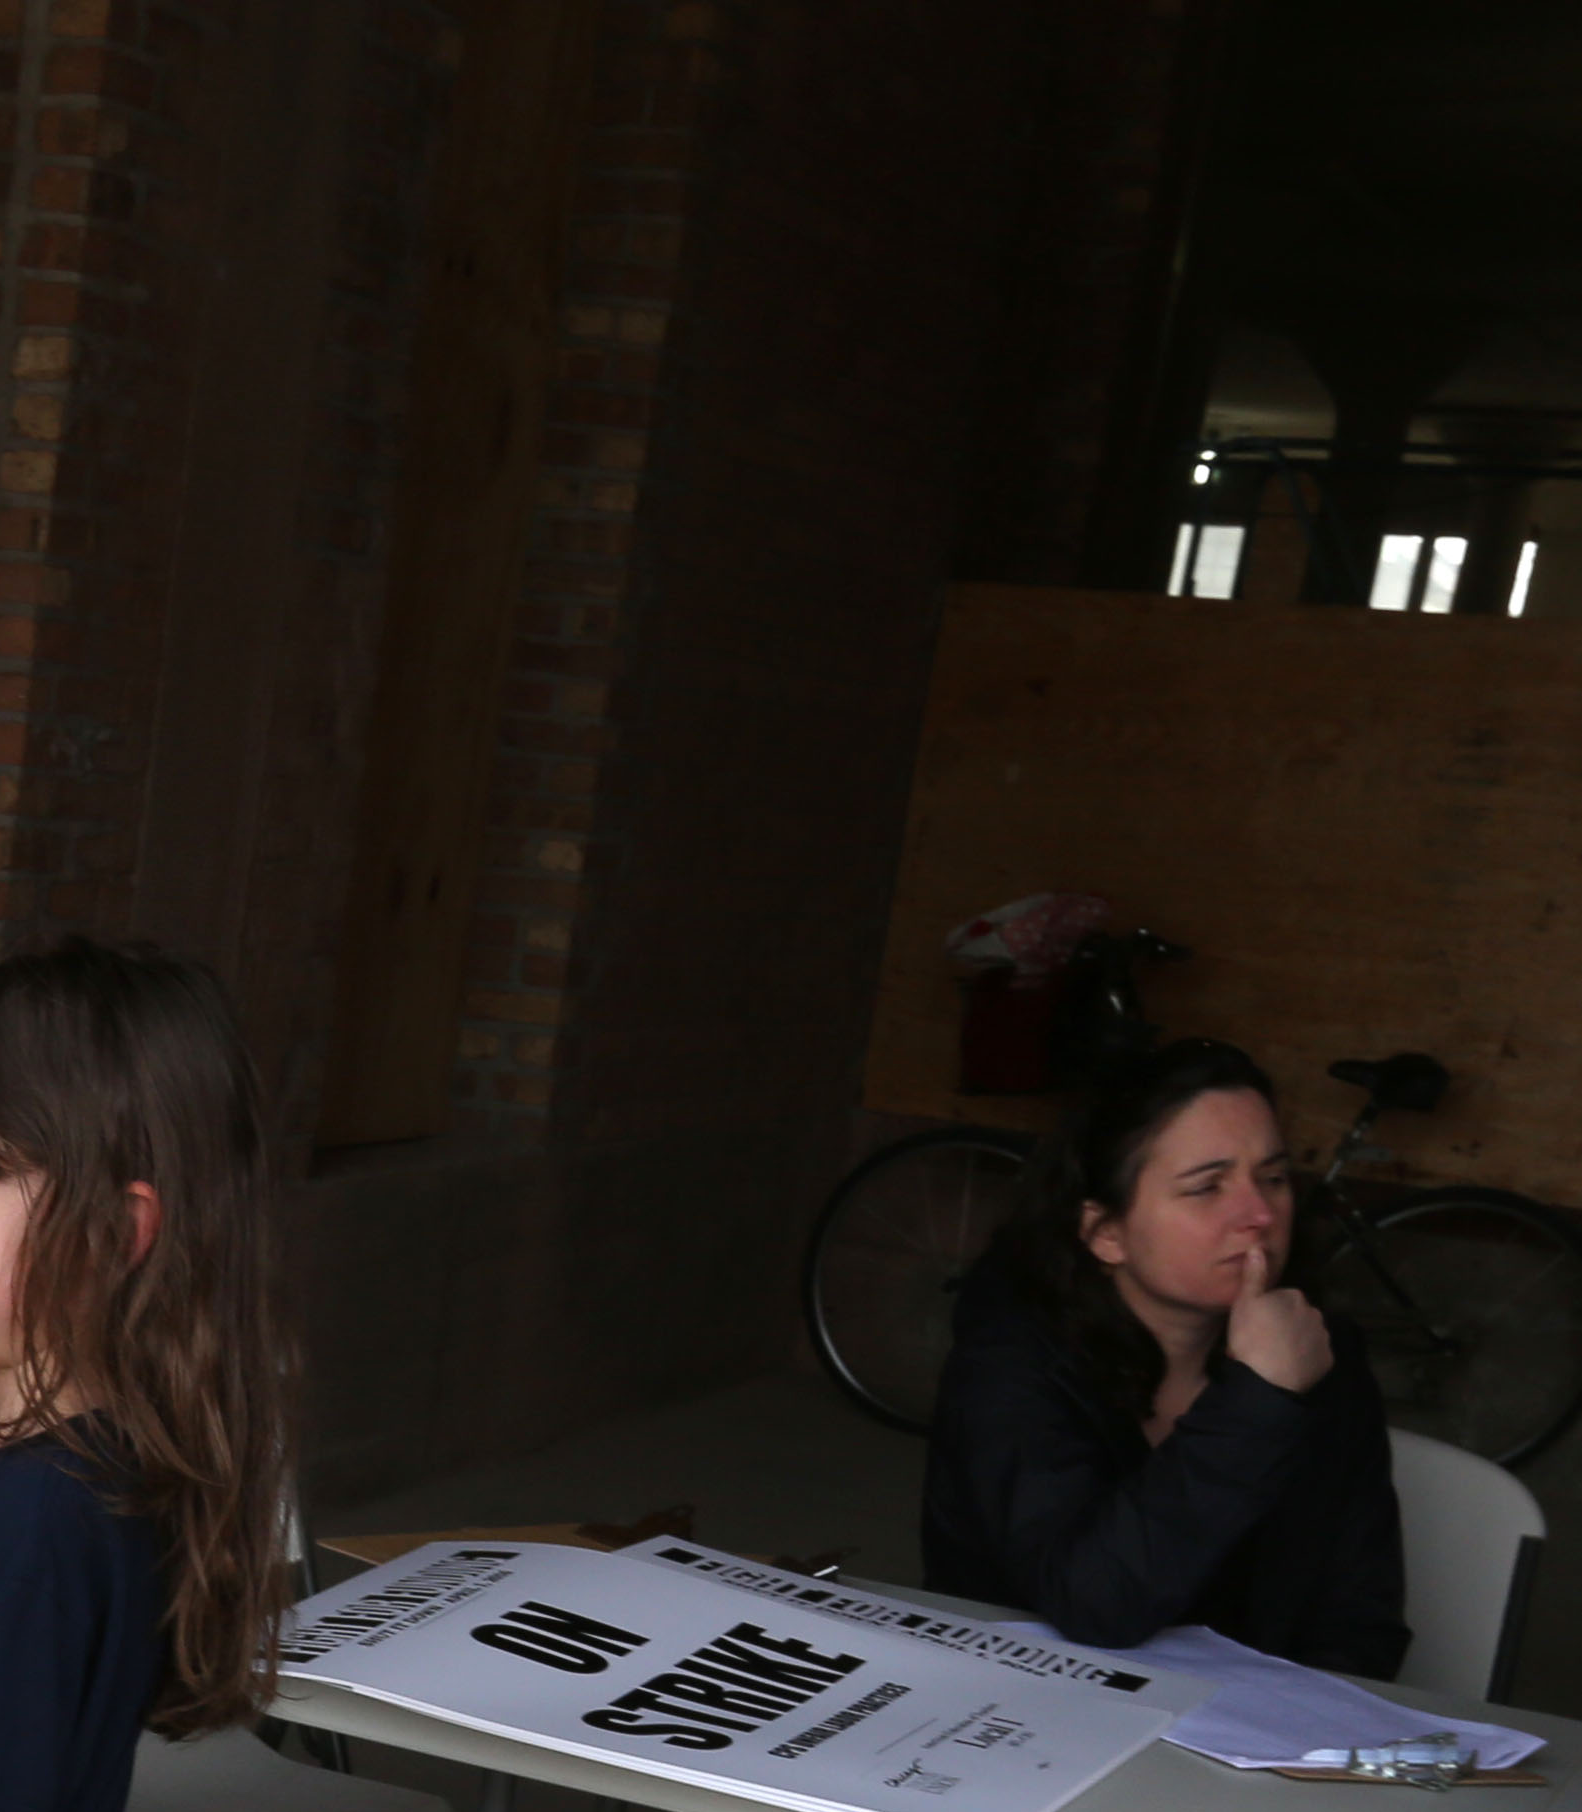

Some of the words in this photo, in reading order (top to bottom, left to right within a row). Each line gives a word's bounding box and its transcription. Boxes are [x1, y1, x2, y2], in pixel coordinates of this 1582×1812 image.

[469, 1600, 651, 1675] ON
[691, 1559, 806, 1597] FIGHT
[822, 1593, 901, 1623] FOR
[921, 1617, 1115, 1681] FUNDING
[580, 1621, 867, 1751] STRIKE
[818, 1710, 868, 1732] LABOR
[846, 1682, 912, 1715] PRACTICES
